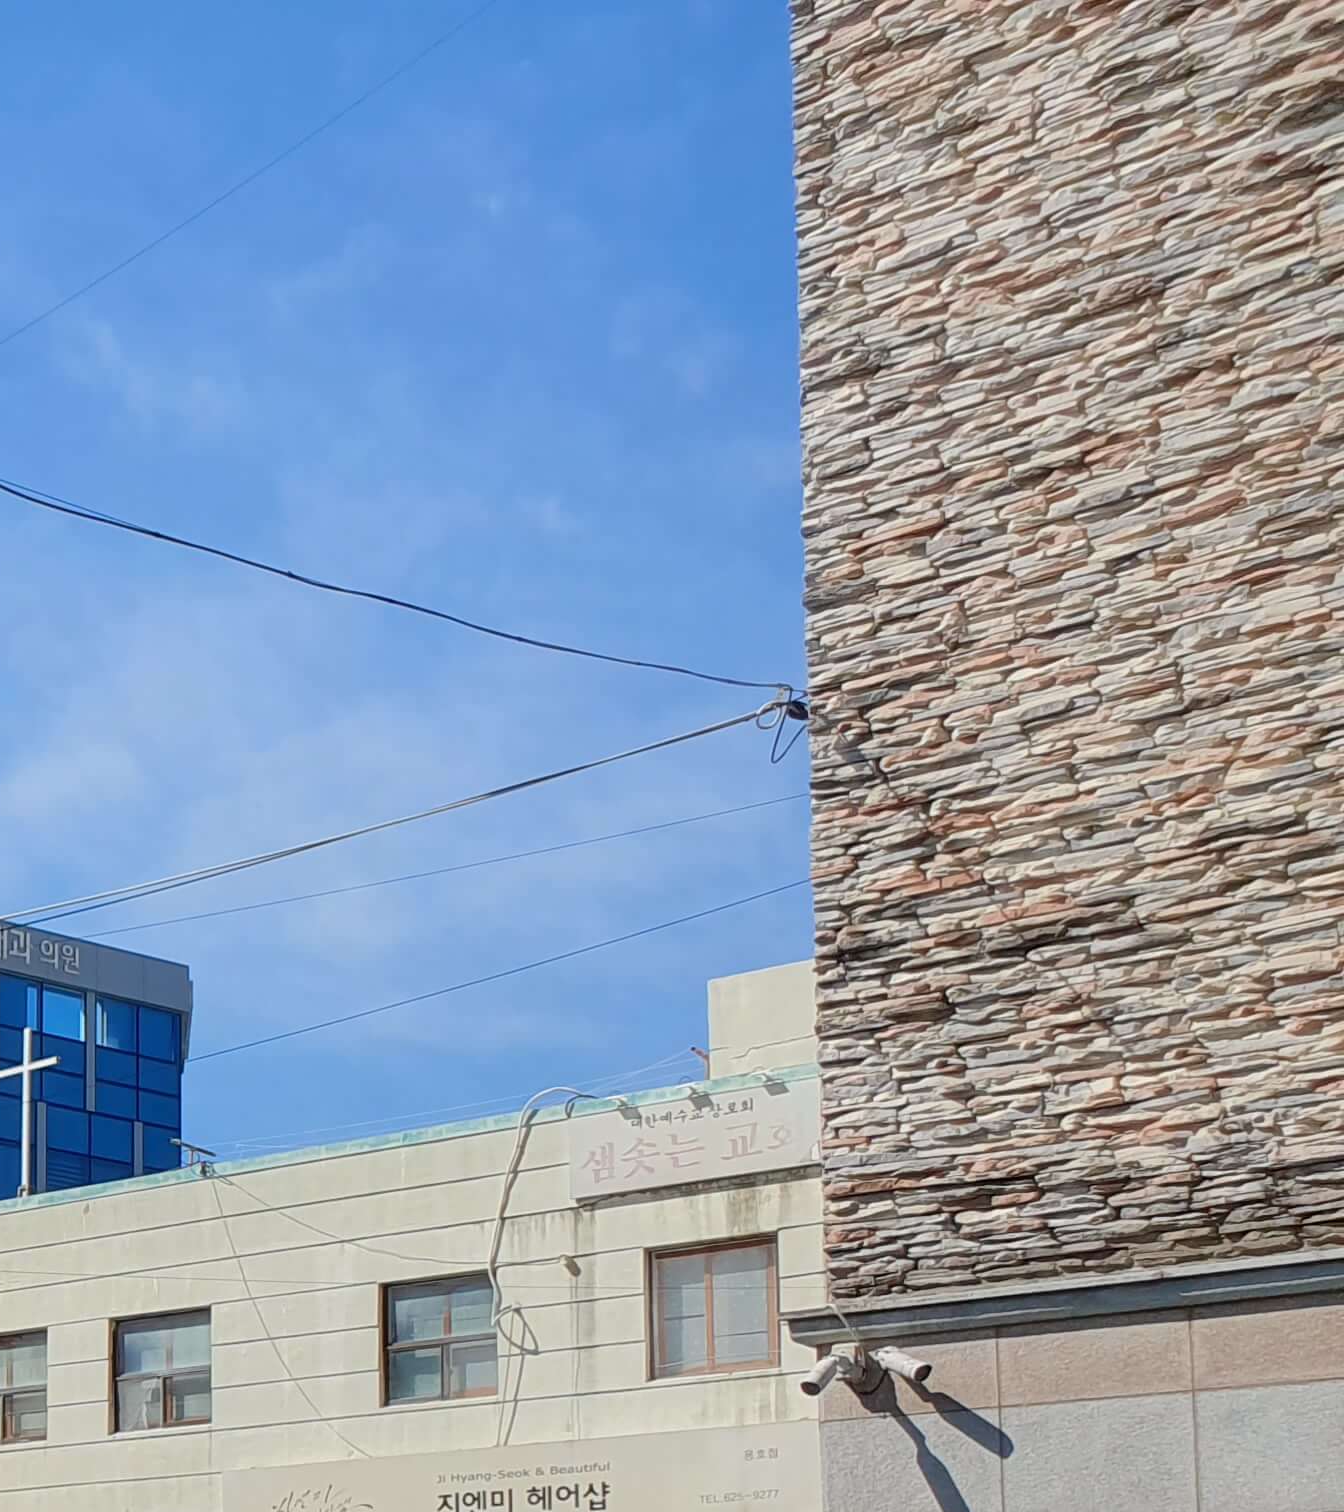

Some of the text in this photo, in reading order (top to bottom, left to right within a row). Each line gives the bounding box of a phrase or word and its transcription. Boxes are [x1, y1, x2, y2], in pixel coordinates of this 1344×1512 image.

[40, 940, 80, 975] 의원
[550, 1461, 611, 1476] Beautiful
[526, 1481, 611, 1512] 헤어샵
